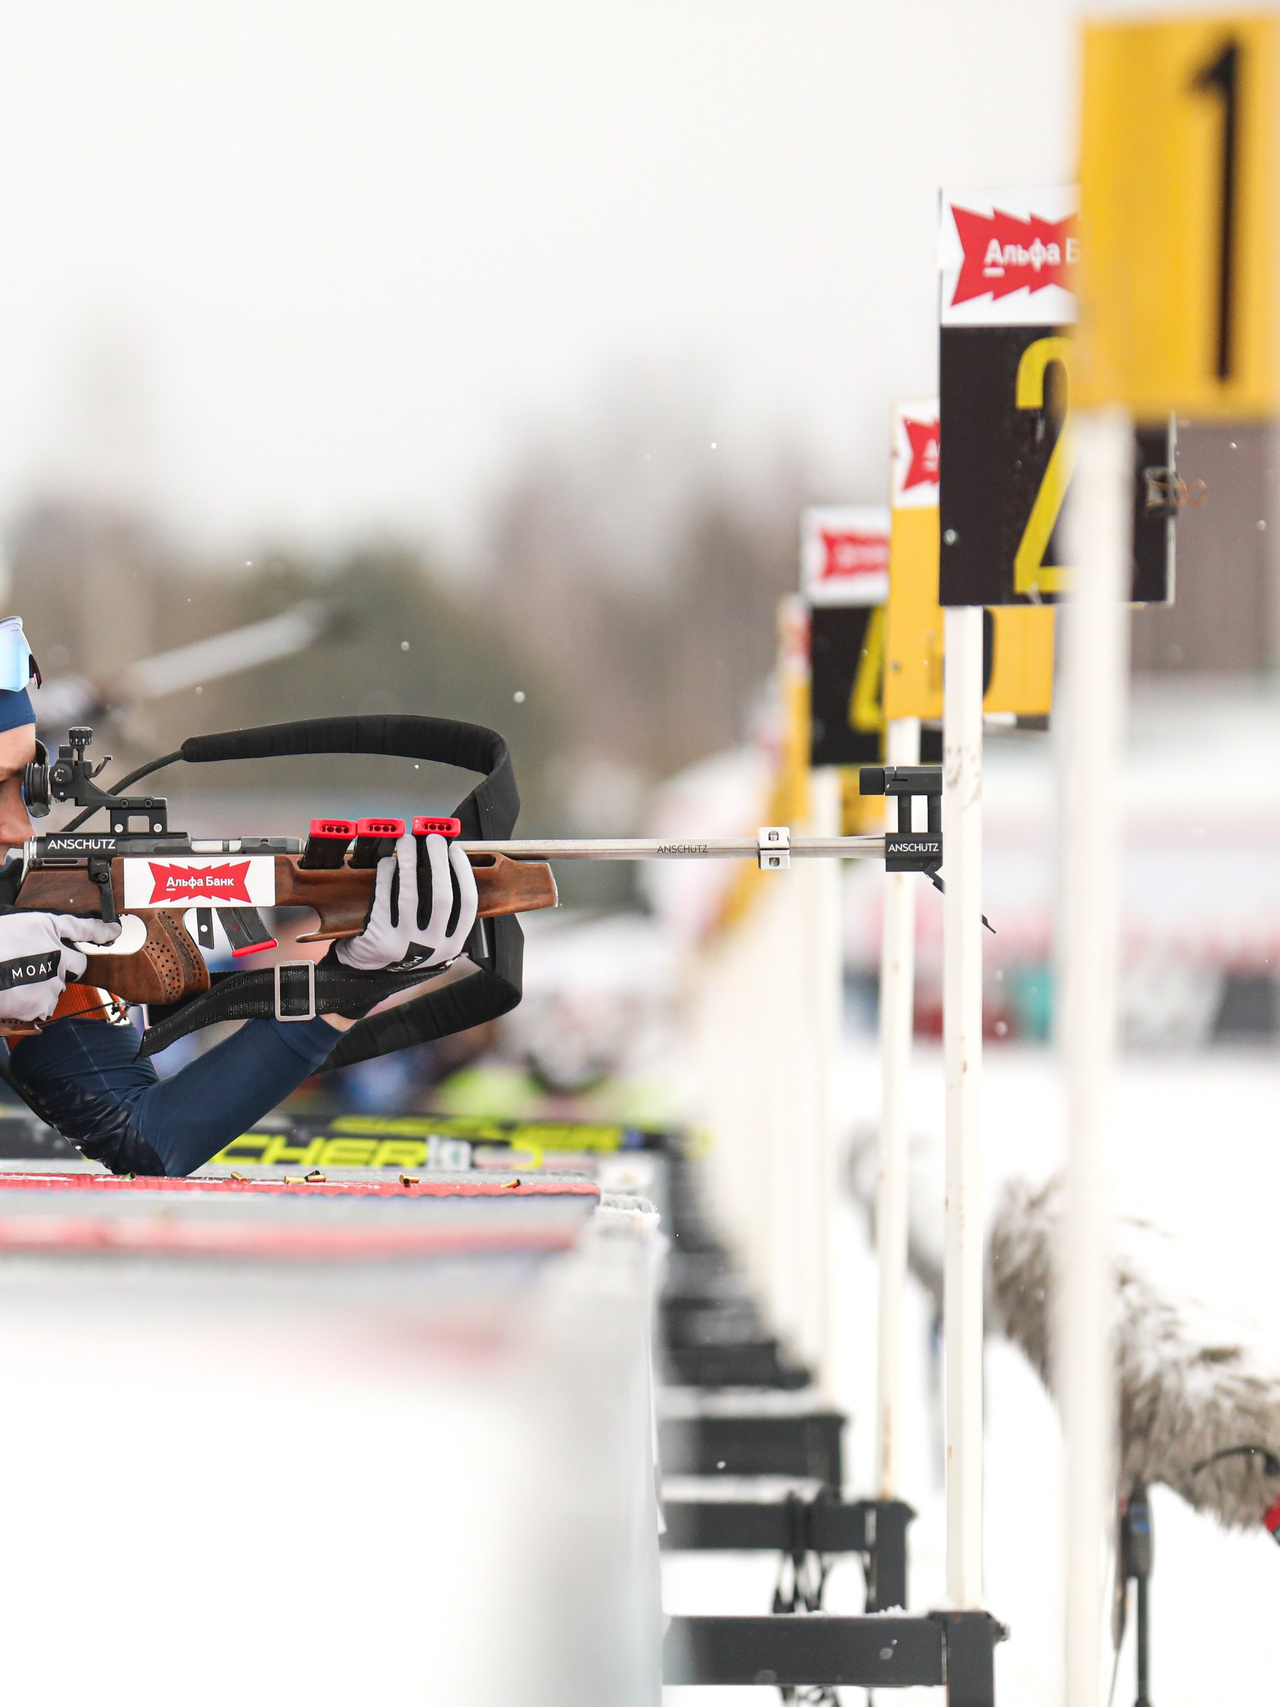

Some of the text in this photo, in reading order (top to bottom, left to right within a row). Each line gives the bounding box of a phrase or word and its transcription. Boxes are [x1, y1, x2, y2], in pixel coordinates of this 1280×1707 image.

[1186, 38, 1242, 384] 1
[983, 237, 1062, 274] Альфа
[1014, 336, 1078, 593] 2
[166, 875, 235, 890] Альфа Банк
[11, 960, 53, 980] MOAX
[208, 1132, 429, 1168] CHER
